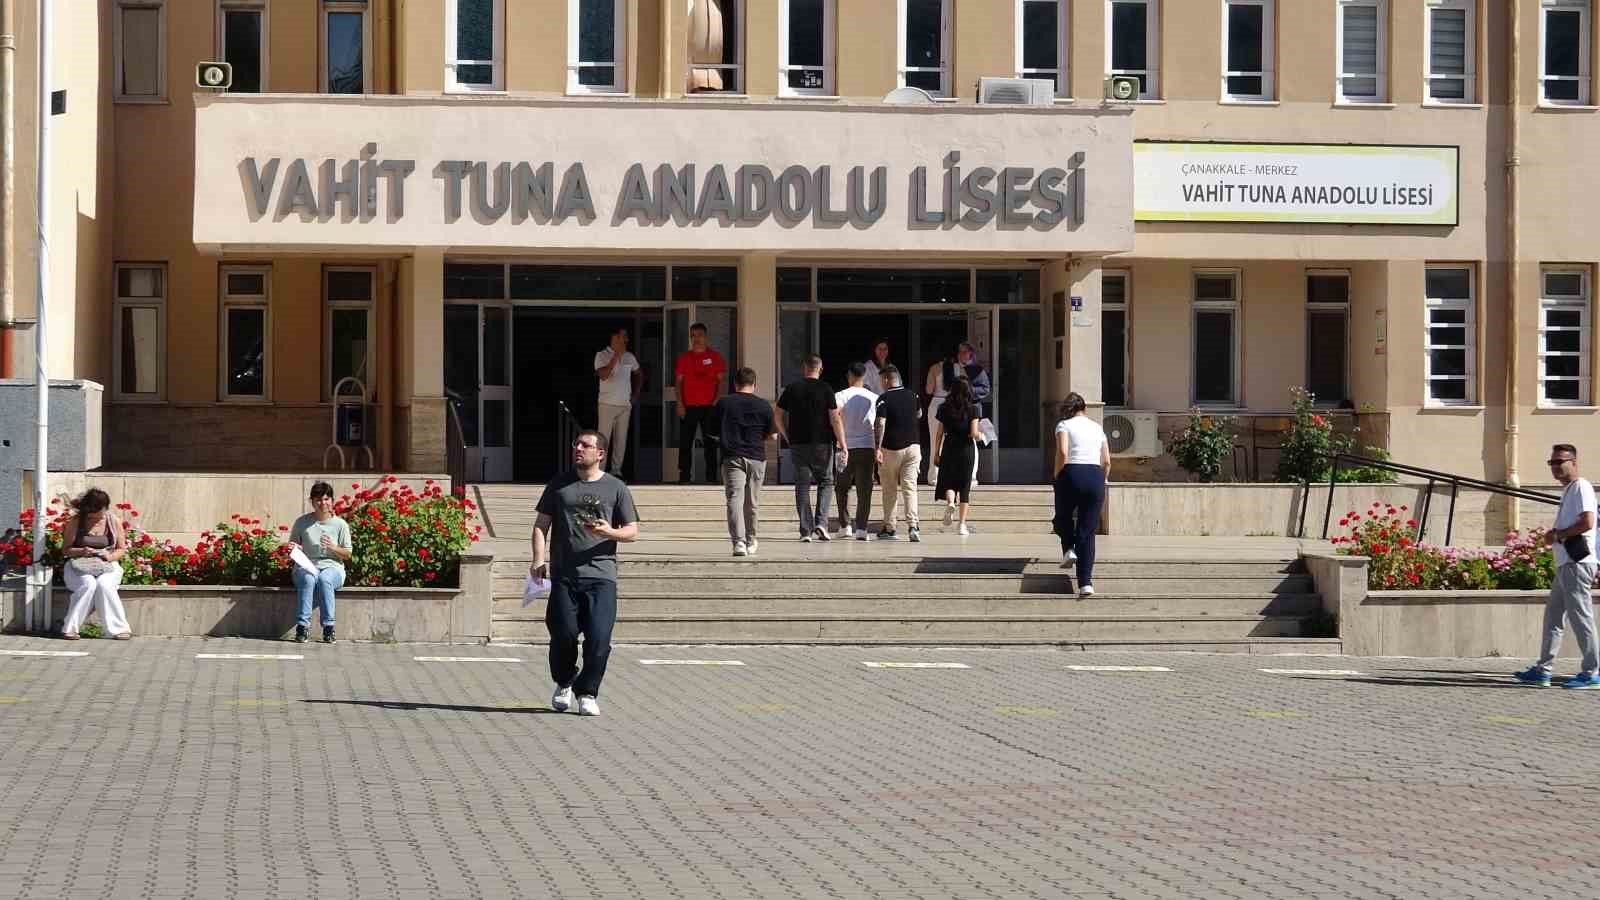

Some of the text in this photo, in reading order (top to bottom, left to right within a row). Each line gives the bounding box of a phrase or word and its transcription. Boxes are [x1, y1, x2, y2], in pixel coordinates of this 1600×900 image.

[1181, 163, 1246, 177] ÇANAKKALE
[1255, 164, 1298, 176] MERKEZ
[236, 142, 1085, 232] VAHİT TUNA ANADOLU LİSESİ
[1182, 181, 1433, 206] VAHİT TUNA ANADOLU LİSESİ
